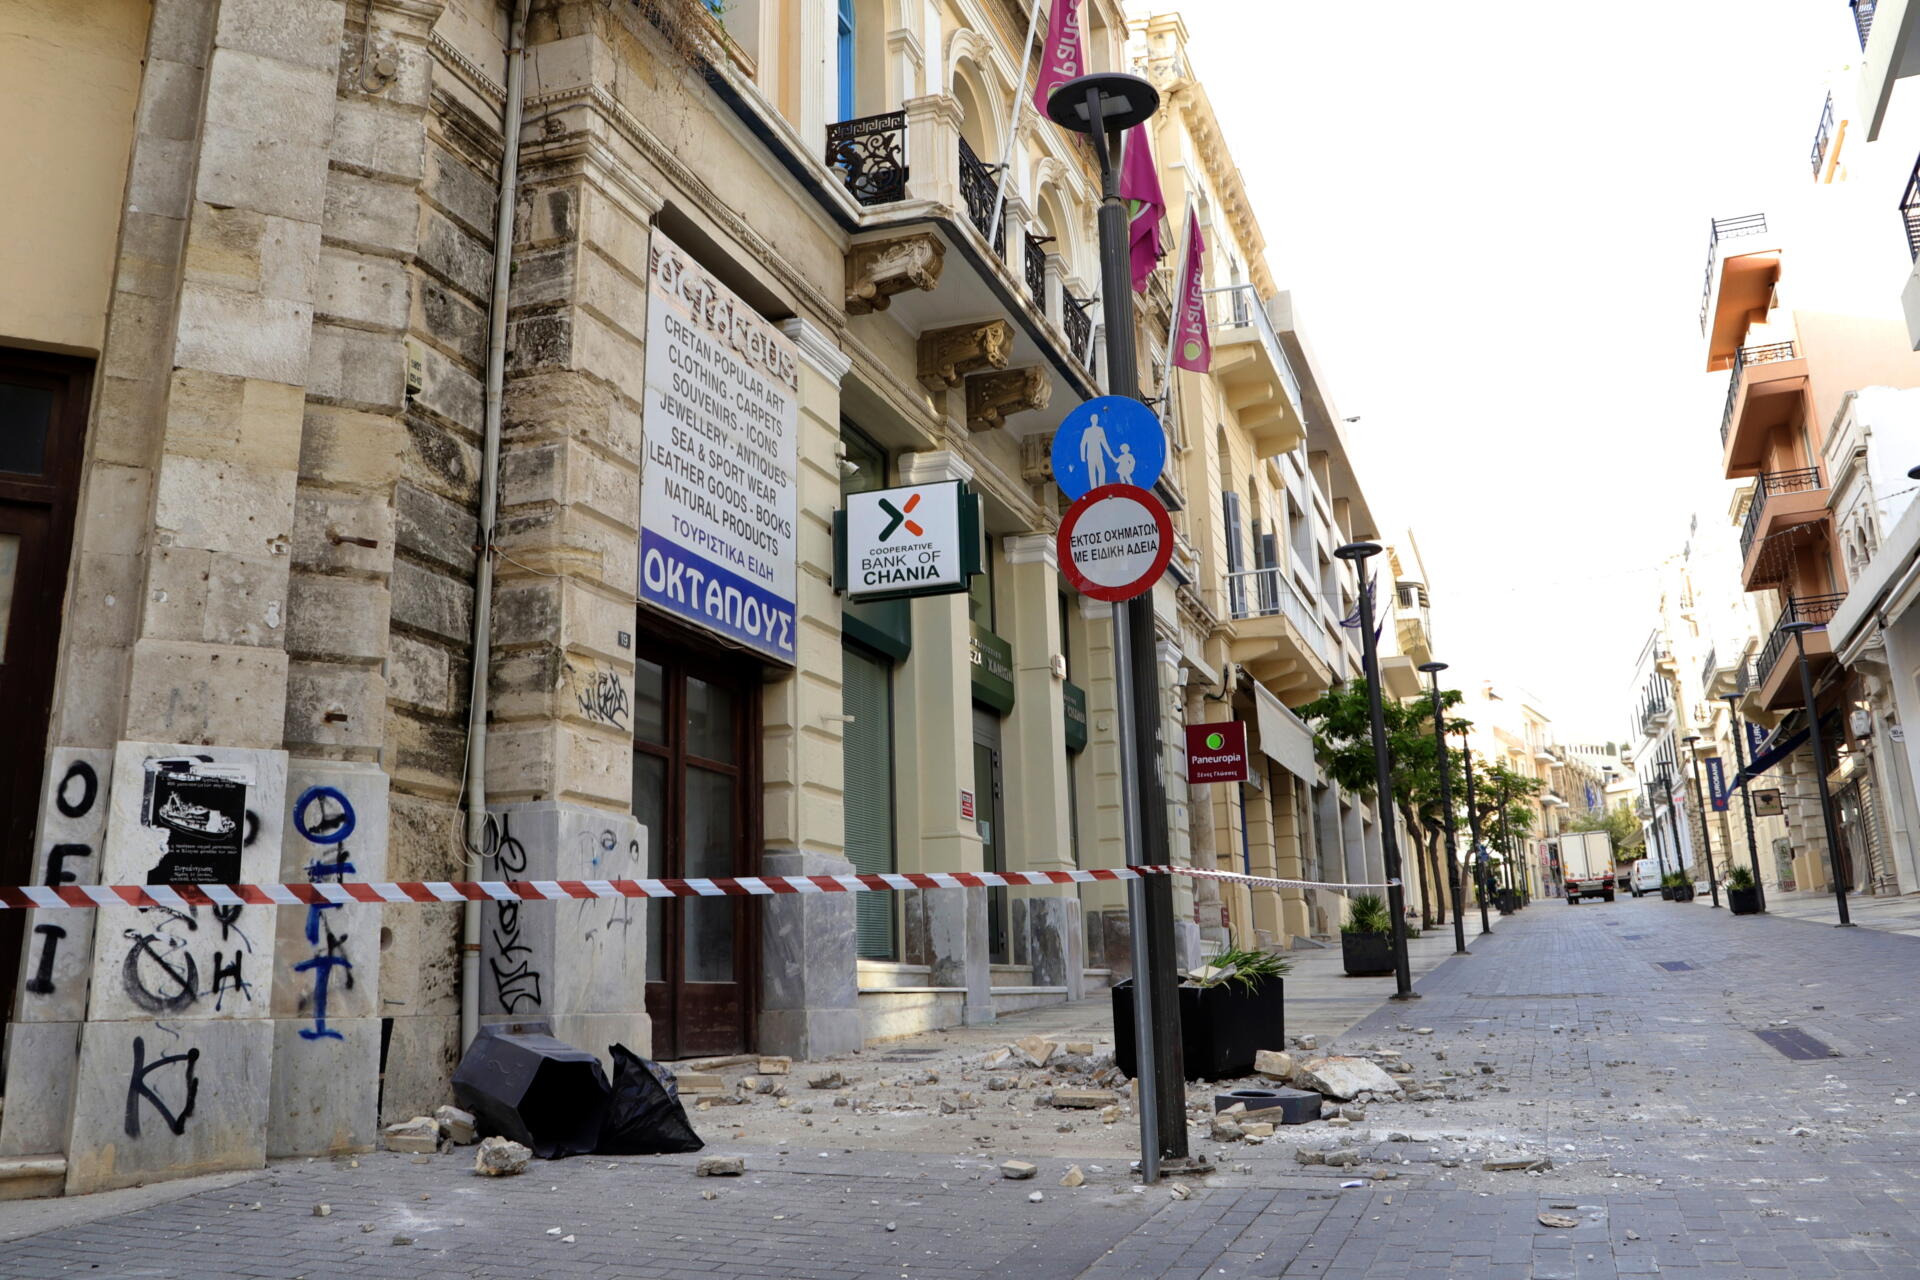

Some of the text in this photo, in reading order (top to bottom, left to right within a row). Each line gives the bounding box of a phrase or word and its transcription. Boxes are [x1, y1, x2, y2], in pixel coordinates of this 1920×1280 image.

[664, 314, 784, 415] CRETAN POPULAR ART
[668, 344, 727, 400] CLOTHING
[736, 392, 783, 438] CARPETS
[660, 394, 728, 448] JEWELLERY
[736, 442, 787, 488] ANTIQUES
[672, 372, 738, 432] SOUVENIRS
[746, 421, 778, 458] ICONS
[650, 440, 704, 489] LEATHER
[707, 475, 748, 513] GOODS
[756, 503, 791, 540] BOOKS
[671, 427, 777, 507] SEA & SPORT WEAR
[664, 477, 778, 556] NATURAL PRODUCTS
[672, 514, 774, 583] ΤΟΥΡΙΣΤΙΚΑ ΕΙΔΗ
[869, 542, 933, 556] COOPERATIVE
[1070, 523, 1158, 548] ΕΚΤΟΣ ΟΧΗΜΑΤΩΝ
[1074, 540, 1157, 563] ΜΕ ΕΙΔΙΚΗ ΑΔΕΙΑ
[862, 550, 941, 570] BANK OF
[863, 565, 940, 585] CHANIA
[643, 548, 793, 652] ΟΚΤΑΠΟΥΣ
[1191, 753, 1241, 764] Paneuropia
[1711, 762, 1722, 797] EUROBANK
